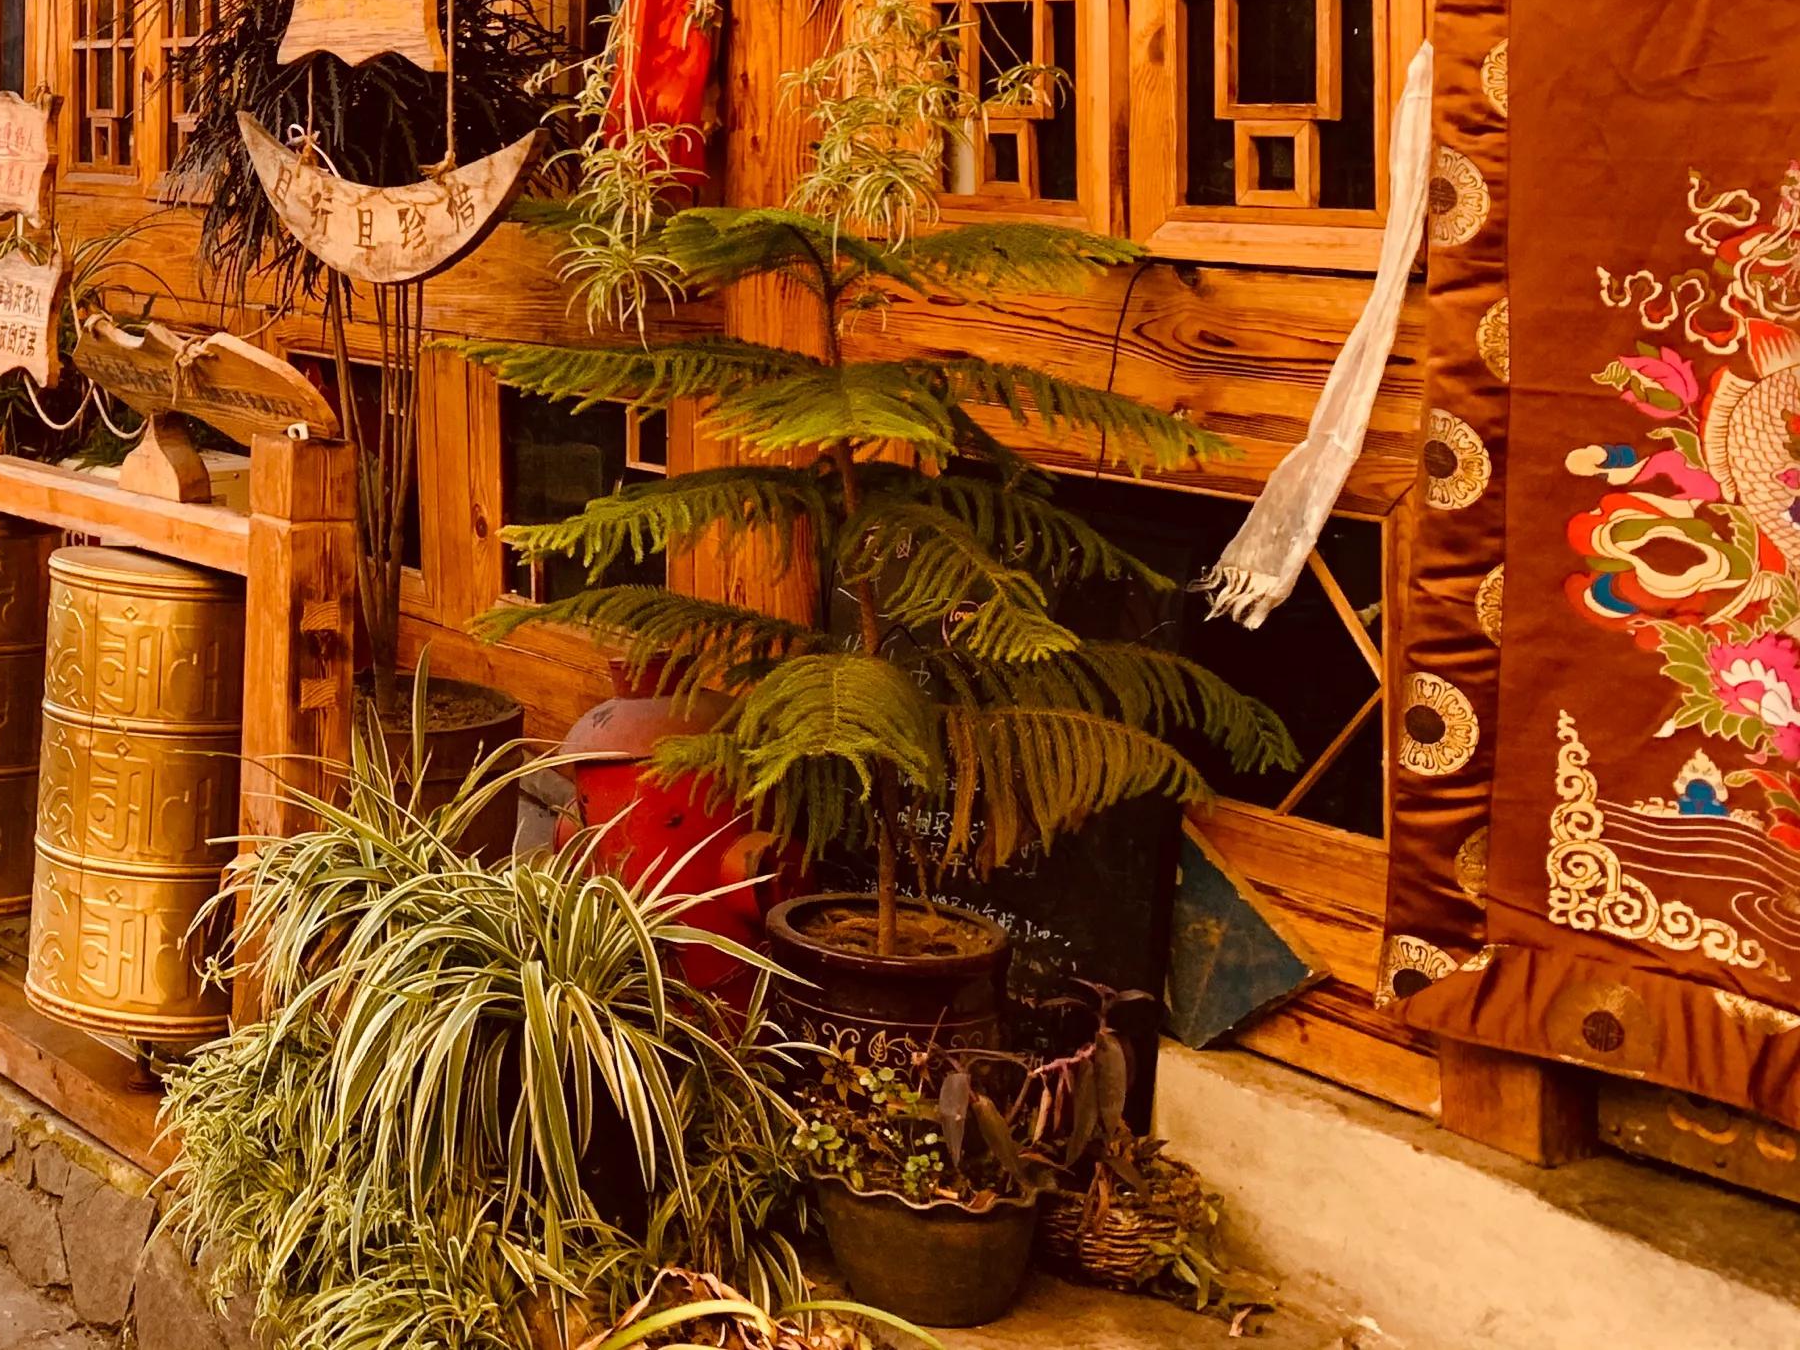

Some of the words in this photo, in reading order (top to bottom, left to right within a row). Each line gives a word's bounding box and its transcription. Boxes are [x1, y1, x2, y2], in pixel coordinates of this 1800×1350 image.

[274, 167, 476, 251] 且行且珍惜
